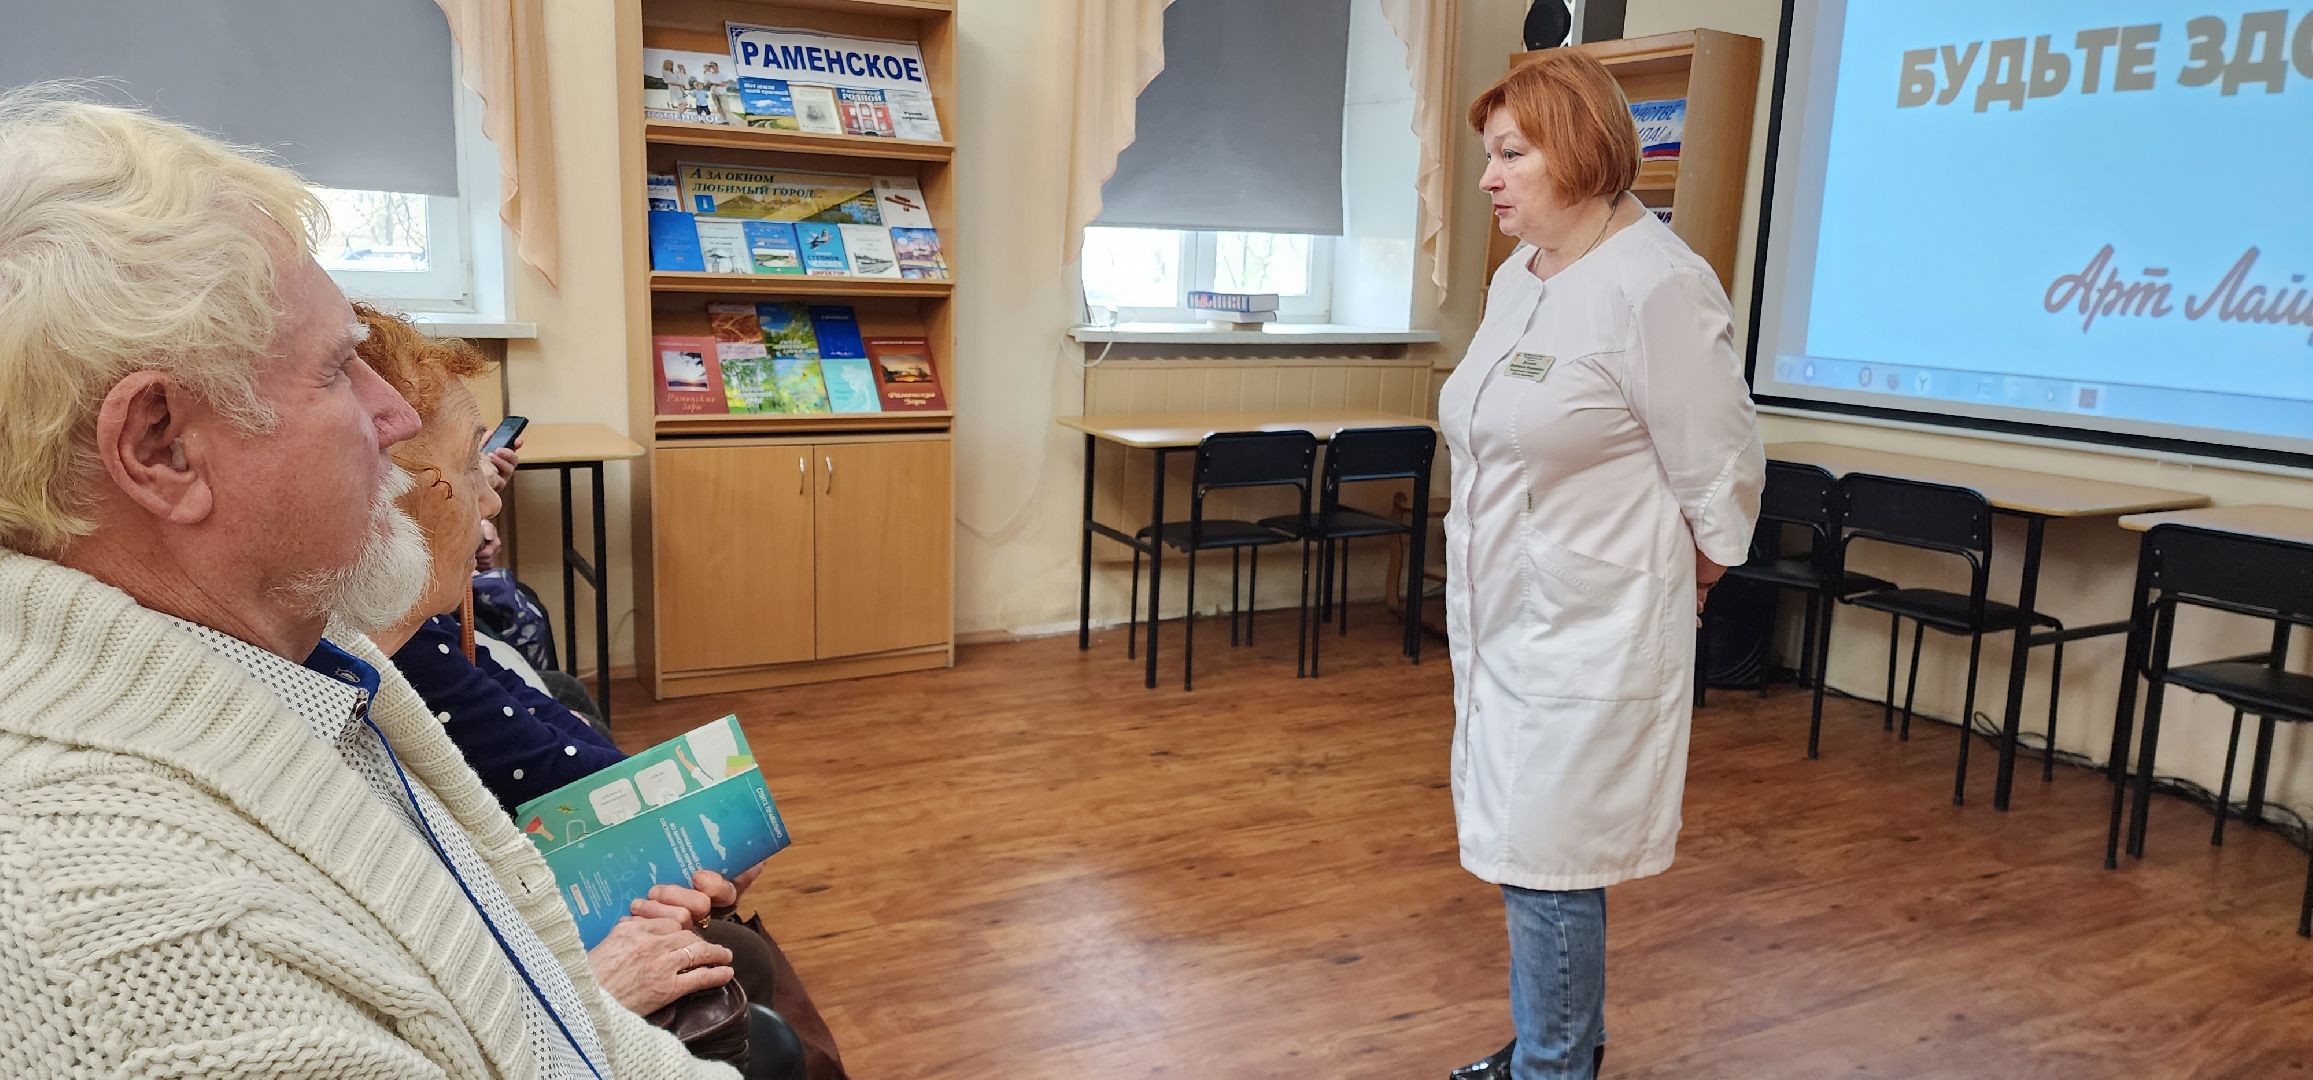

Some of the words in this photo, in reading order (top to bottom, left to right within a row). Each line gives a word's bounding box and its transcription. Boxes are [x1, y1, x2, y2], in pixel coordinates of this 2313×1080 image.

[741, 41, 922, 82] РАМЕНСКОЕ
[1896, 23, 2162, 113] БУДЬТЕ
[691, 168, 701, 179] А
[706, 171, 721, 180] ЗА
[725, 172, 774, 183] ОКНОМ
[692, 183, 768, 195] ЛЮБИМЫЙ
[2044, 244, 2173, 333] Арт
